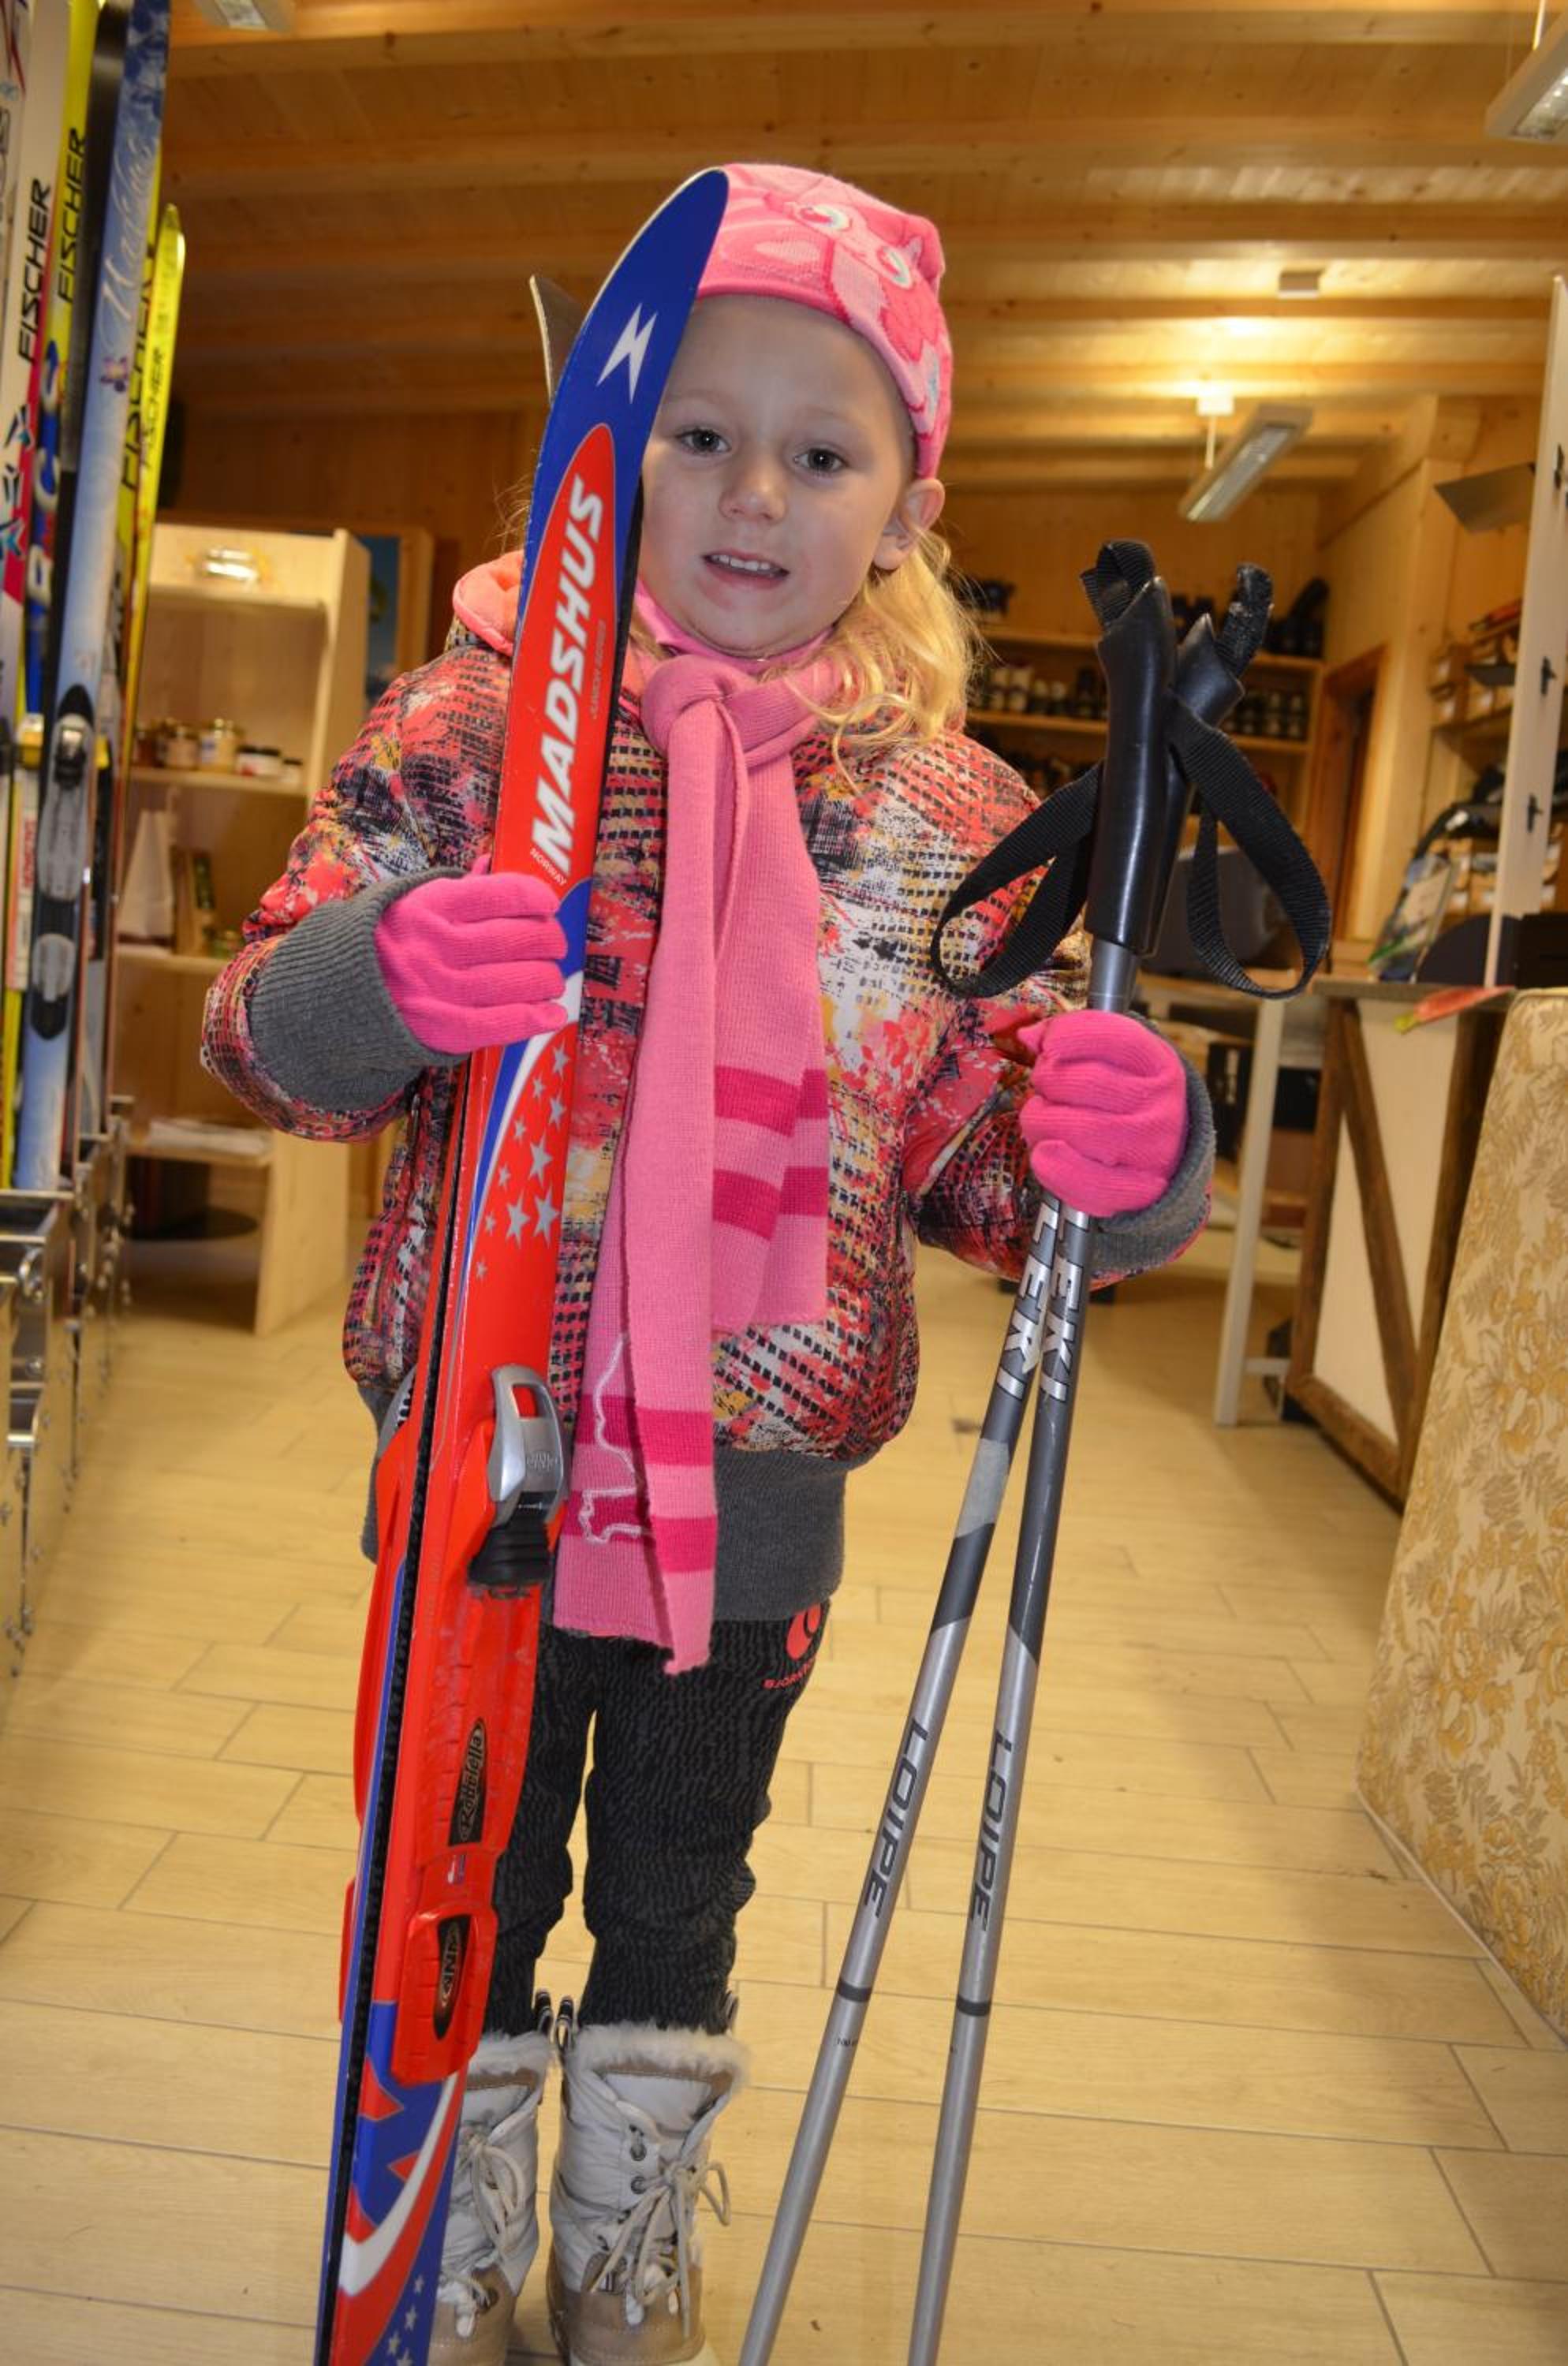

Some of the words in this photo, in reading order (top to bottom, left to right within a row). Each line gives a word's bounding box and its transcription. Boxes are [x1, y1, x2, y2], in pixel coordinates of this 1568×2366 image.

[17, 177, 50, 364] FISCHER
[58, 128, 87, 304] FISCHER
[532, 473, 604, 875] MADSHUS
[529, 845, 568, 887] NORWAY
[997, 1202, 1059, 1401] LEKI
[864, 1717, 928, 1917] LOIPE
[971, 1730, 1012, 1931] LOIPE
